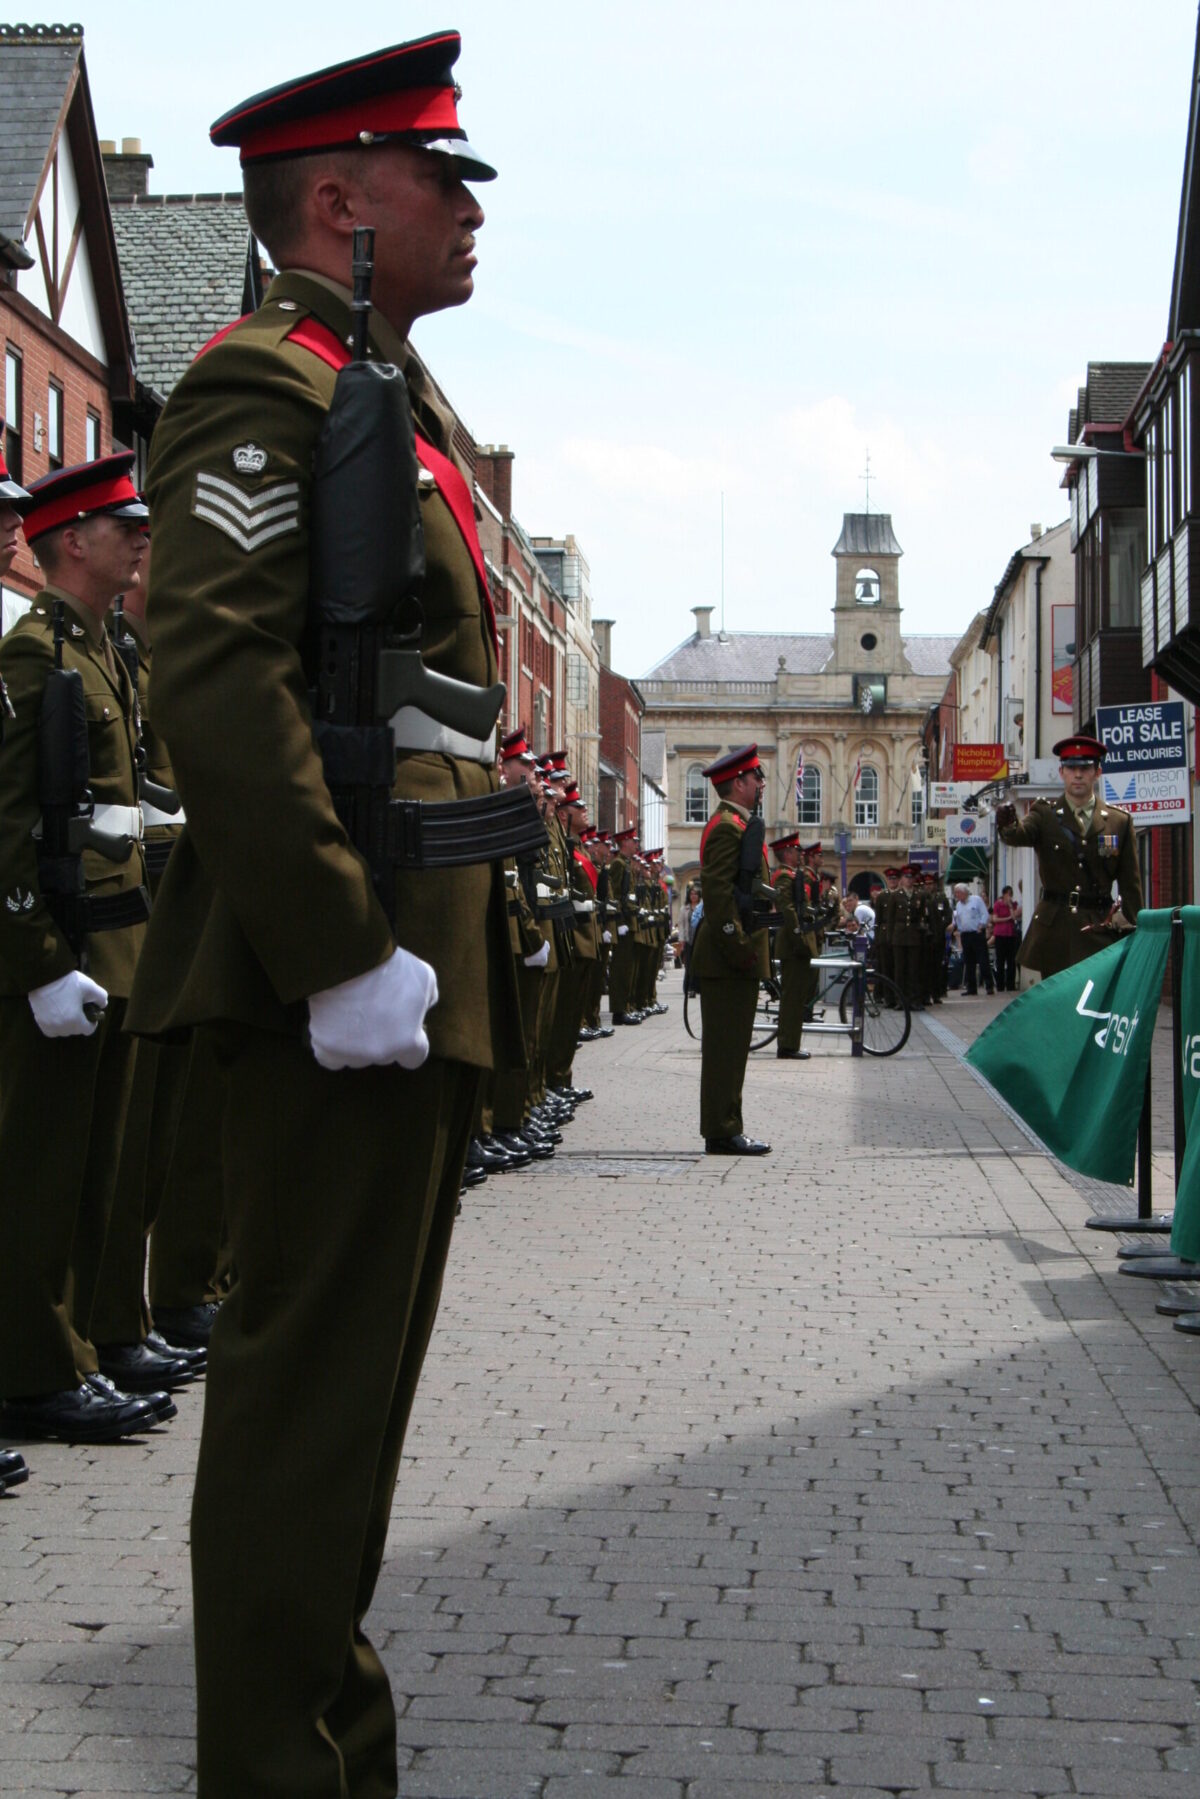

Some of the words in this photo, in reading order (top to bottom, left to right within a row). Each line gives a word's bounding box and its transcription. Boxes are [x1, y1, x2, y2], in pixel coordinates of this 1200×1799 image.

[1119, 707, 1162, 724] LEASE
[1102, 726, 1134, 745] FOR
[1140, 721, 1182, 742] SALE
[957, 748, 990, 757] Nicholas
[1105, 752, 1124, 763] ALL
[1127, 746, 1182, 761] ENQUIRIES
[957, 757, 1001, 767] Humphreys
[1138, 769, 1185, 784] mason
[1139, 785, 1177, 799] owen
[1136, 801, 1153, 812] 242
[1157, 799, 1181, 809] 3000
[949, 836, 988, 845] OPTICIANS
